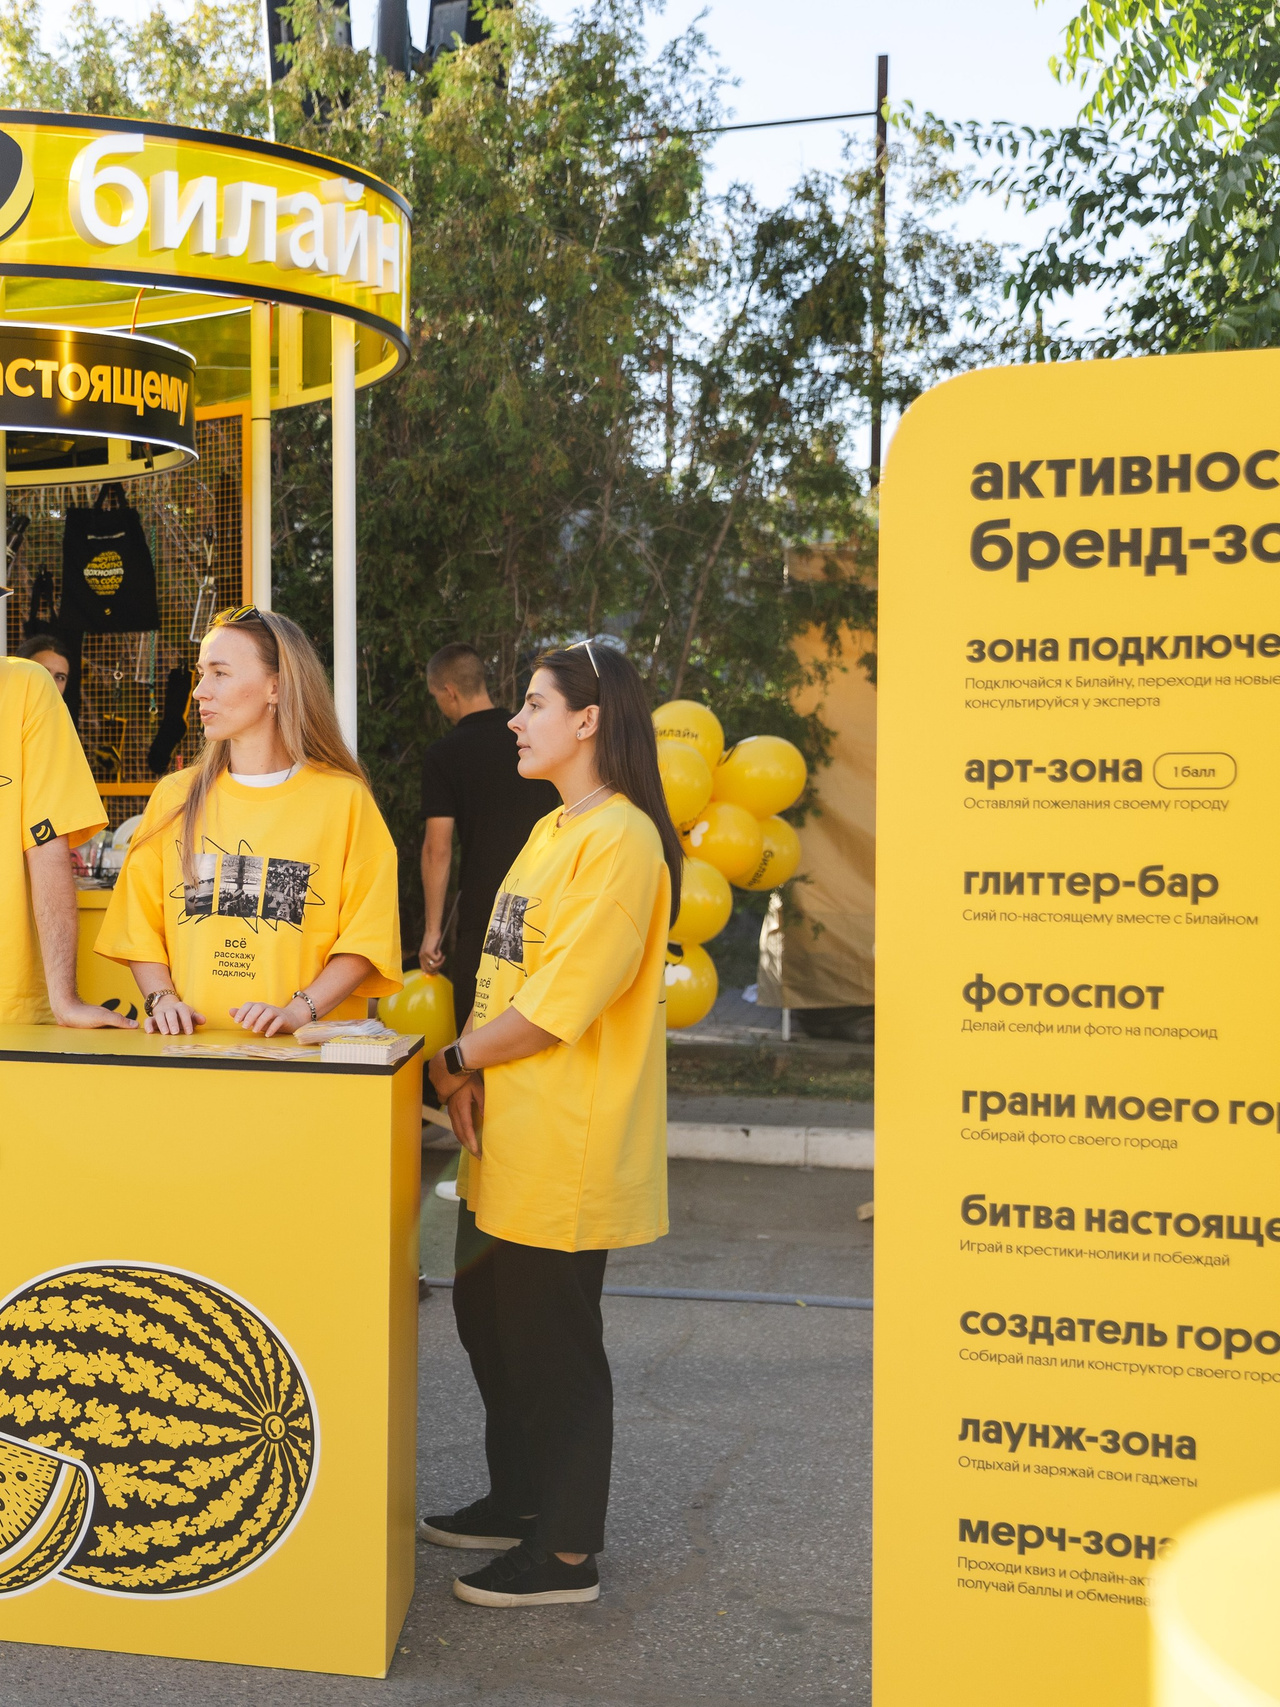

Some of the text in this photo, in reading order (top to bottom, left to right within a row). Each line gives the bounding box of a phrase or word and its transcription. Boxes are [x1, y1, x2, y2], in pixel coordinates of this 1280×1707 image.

[68, 133, 400, 295] билайн
[970, 449, 1280, 501] активнос
[970, 517, 1280, 583] бренд-зо
[965, 632, 1280, 667] зона подключе
[965, 674, 1280, 691] Подключайся к Билайну, переходи на новые
[964, 695, 1161, 711] консультируйся у эксперта
[964, 758, 1216, 791] арт-зона 1 балл
[963, 796, 1230, 812] Оставляй пожелания своему городу
[963, 864, 1220, 906] глиттер-бар
[962, 908, 1259, 926] Сияй по-настоящему вместе с Билайном
[214, 951, 256, 962] расскажу
[224, 937, 247, 949] всё
[212, 969, 256, 980] подключу
[218, 960, 251, 970] покажу
[962, 972, 1165, 1013] фотоспот
[960, 1018, 1219, 1041] Делай селфи или фото на полароид
[961, 1089, 1280, 1135] грани моего го
[960, 1127, 1178, 1151] Собирай фото своего города
[960, 1193, 1076, 1232] битва
[959, 1239, 1230, 1268] Играй в крестики-нолики и побеждай
[959, 1310, 1280, 1361] создатель горо
[958, 1348, 1024, 1366] Собирай
[1026, 1355, 1058, 1367] пазл
[1060, 1357, 1085, 1369] или
[1087, 1360, 1185, 1379] конструктор
[1186, 1366, 1242, 1380] своего
[958, 1417, 1197, 1461] лаунж-зона
[957, 1455, 1198, 1488] Отдыхай и заряжай свои гаджеты
[957, 1556, 1022, 1576] Проходи
[1024, 1565, 1056, 1578] квиз
[1058, 1568, 1067, 1579] и
[957, 1577, 1015, 1593] получай
[1017, 1581, 1063, 1598] баллы
[1065, 1589, 1074, 1599] и
